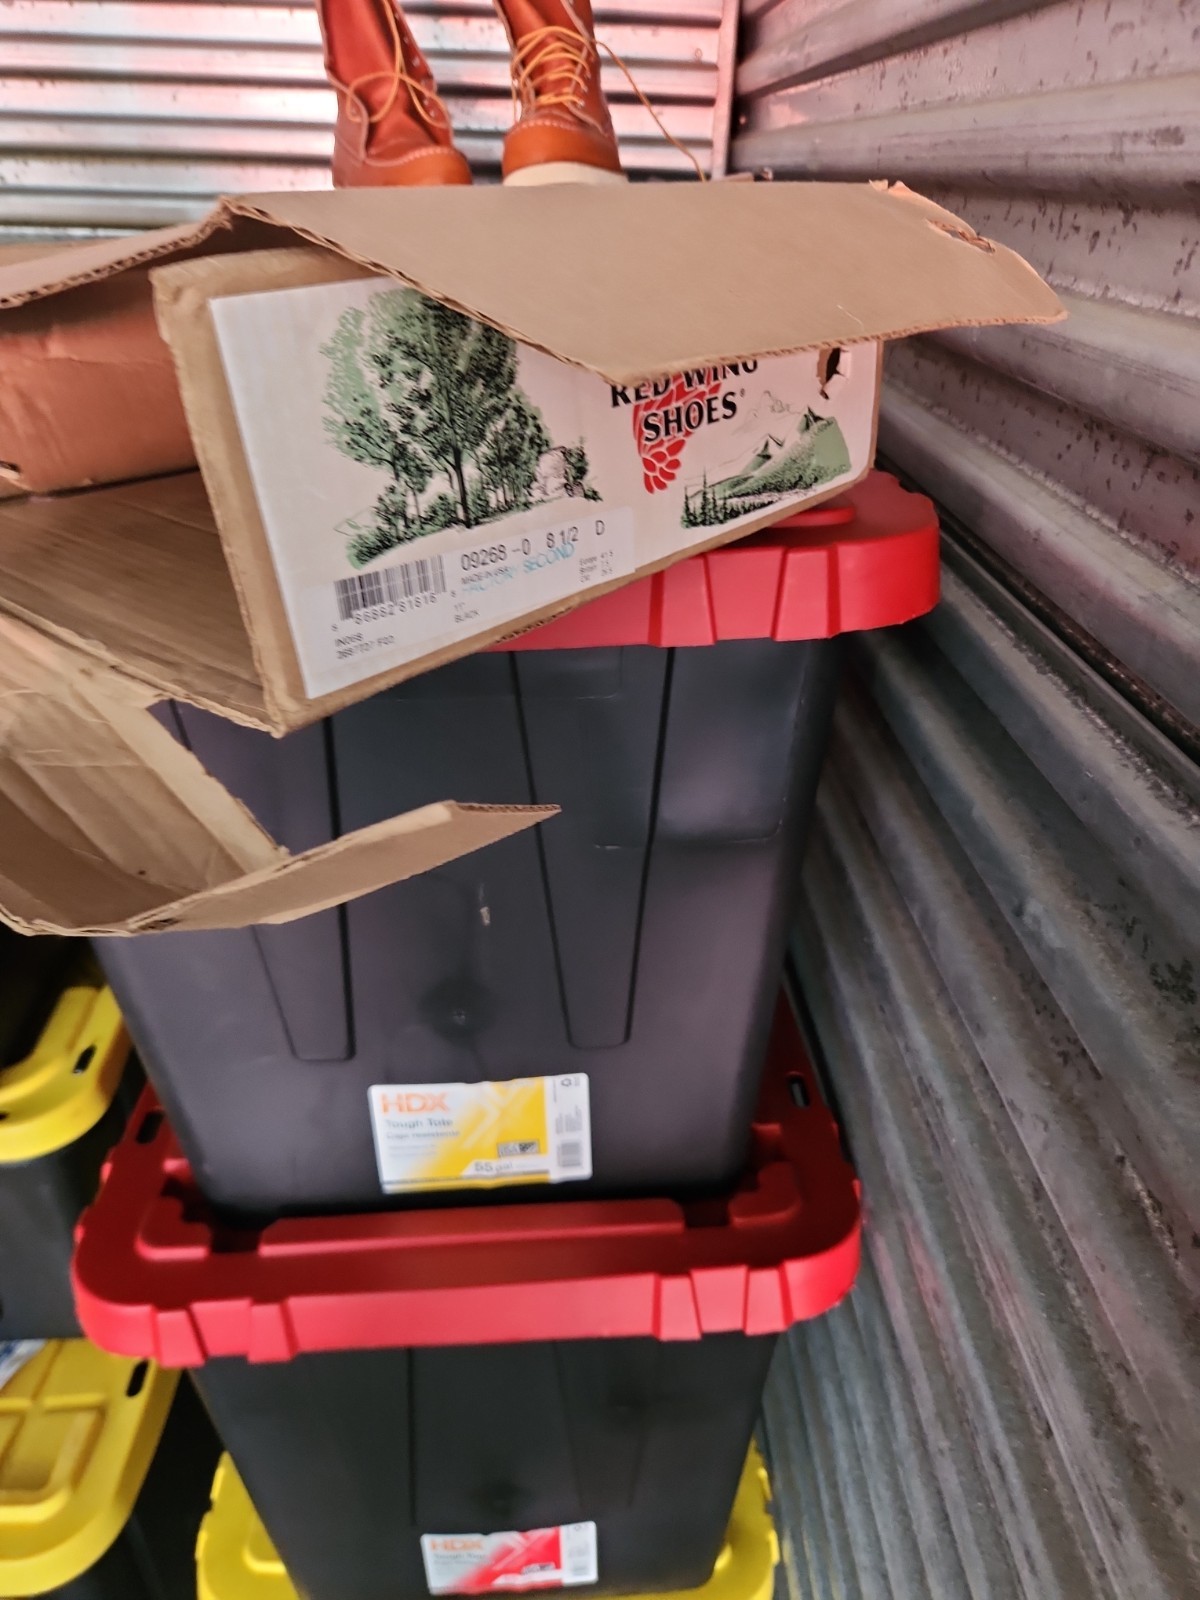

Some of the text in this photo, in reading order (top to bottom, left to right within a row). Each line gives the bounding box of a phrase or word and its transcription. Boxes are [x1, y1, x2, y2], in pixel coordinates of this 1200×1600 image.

[611, 372, 671, 408] RED
[643, 391, 737, 443] SHOES
[595, 519, 606, 536] D
[522, 541, 576, 574] SECOND
[381, 1091, 449, 1114] HDX
